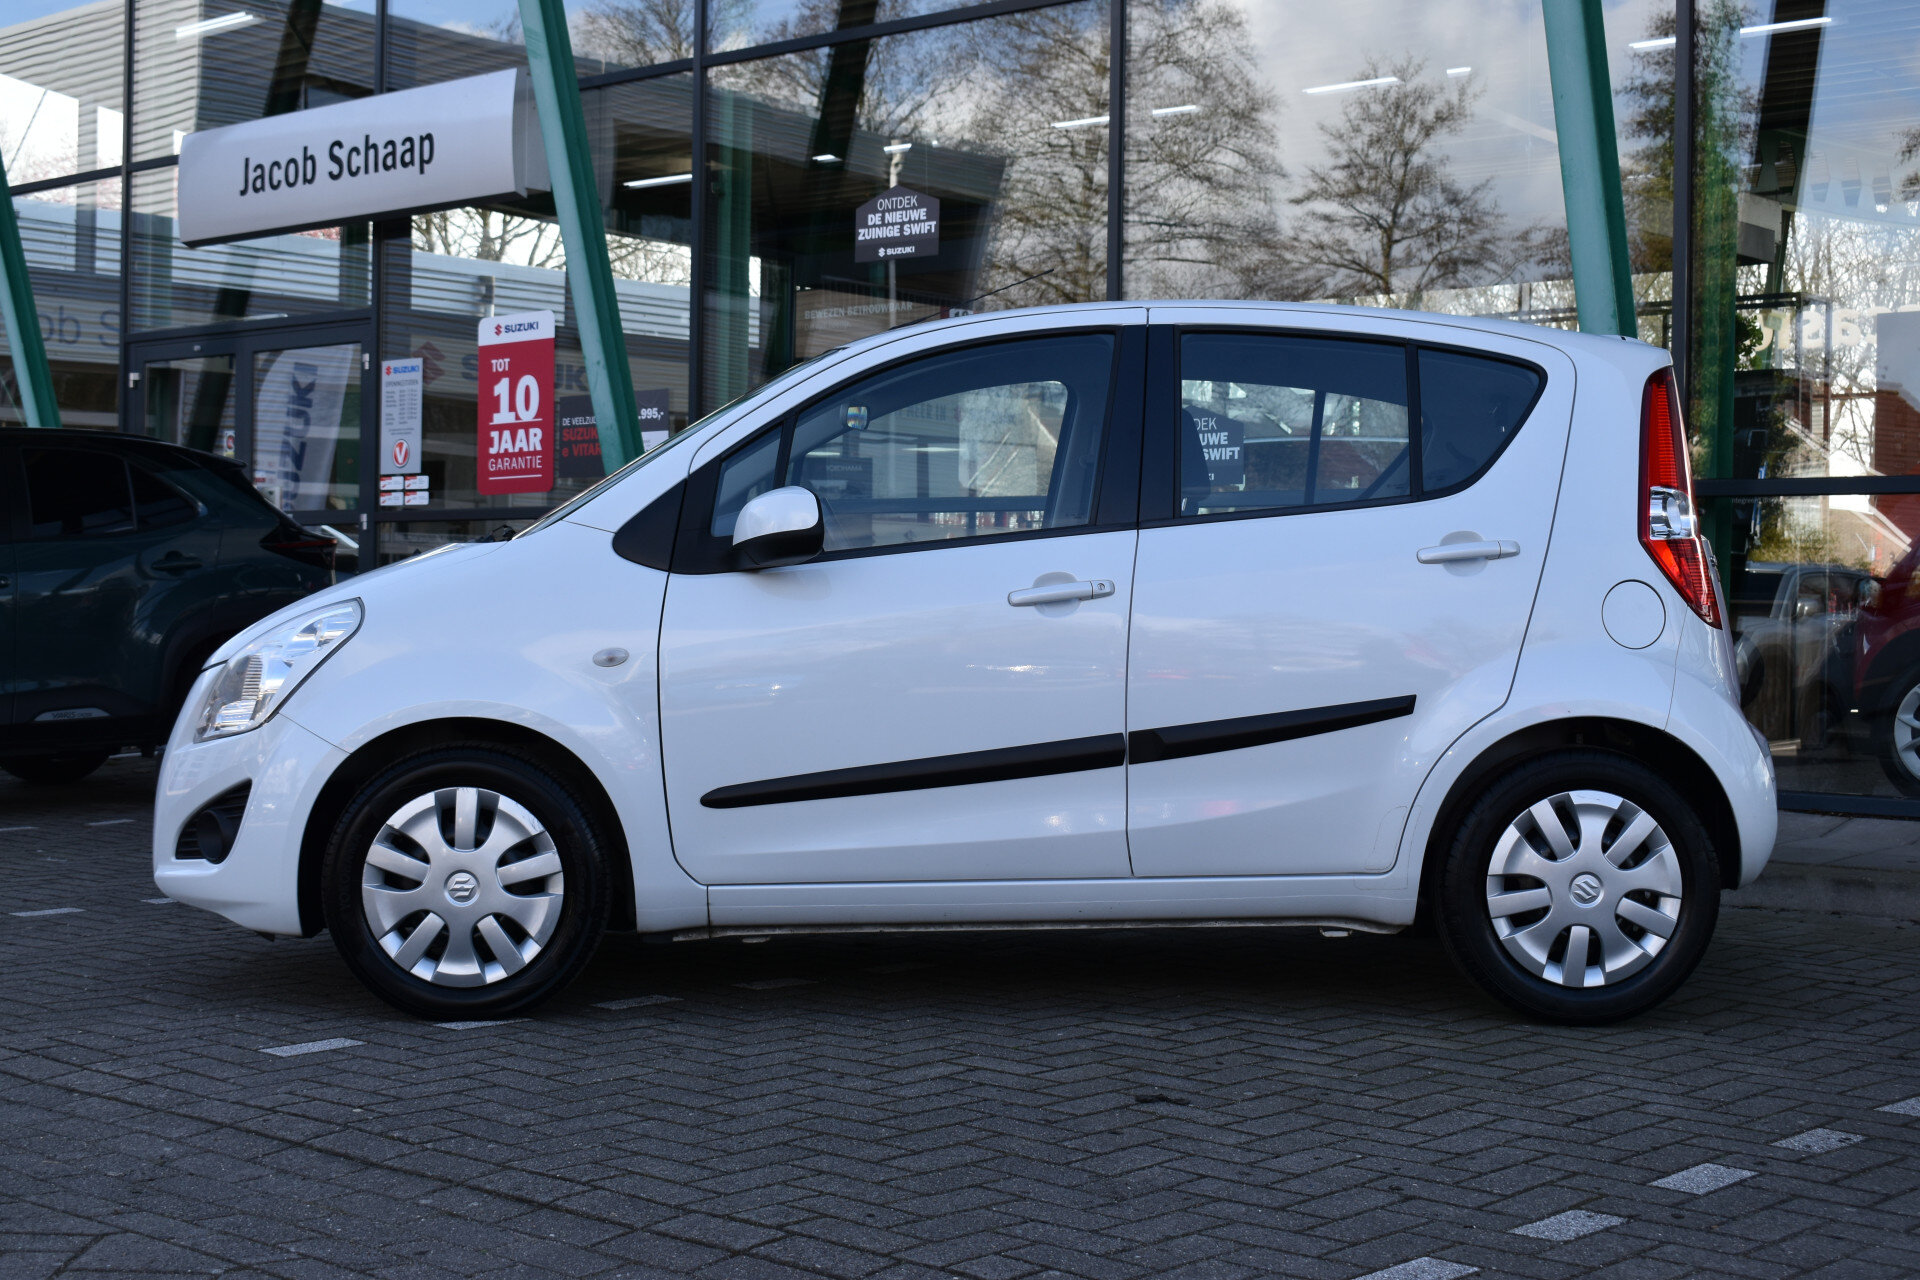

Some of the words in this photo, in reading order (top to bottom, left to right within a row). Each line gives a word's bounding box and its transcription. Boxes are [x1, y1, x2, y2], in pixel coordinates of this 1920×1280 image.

[240, 146, 317, 197] Jacob
[328, 132, 435, 181] Schaap
[877, 195, 918, 211] ONTDEK
[867, 213, 882, 226] DE
[884, 208, 927, 224] NIEUWE
[858, 225, 900, 240] ZUINIGE
[903, 221, 936, 236] SWIFT
[886, 246, 915, 256] SUZUKI
[504, 321, 539, 333] SUZUKI
[393, 365, 419, 374] SUZUKI
[491, 358, 510, 373] TOT
[493, 374, 540, 423] 10
[638, 407, 664, 421] .995,-
[562, 417, 571, 427] DE
[1193, 417, 1217, 431] DEK
[489, 427, 542, 454] JAAR
[562, 427, 599, 442] SUZUK
[1199, 432, 1228, 446] UWE
[561, 447, 570, 457] e
[572, 442, 602, 457] VITAR
[1202, 447, 1240, 461] SWIFT
[489, 455, 543, 471] GARANTIE
